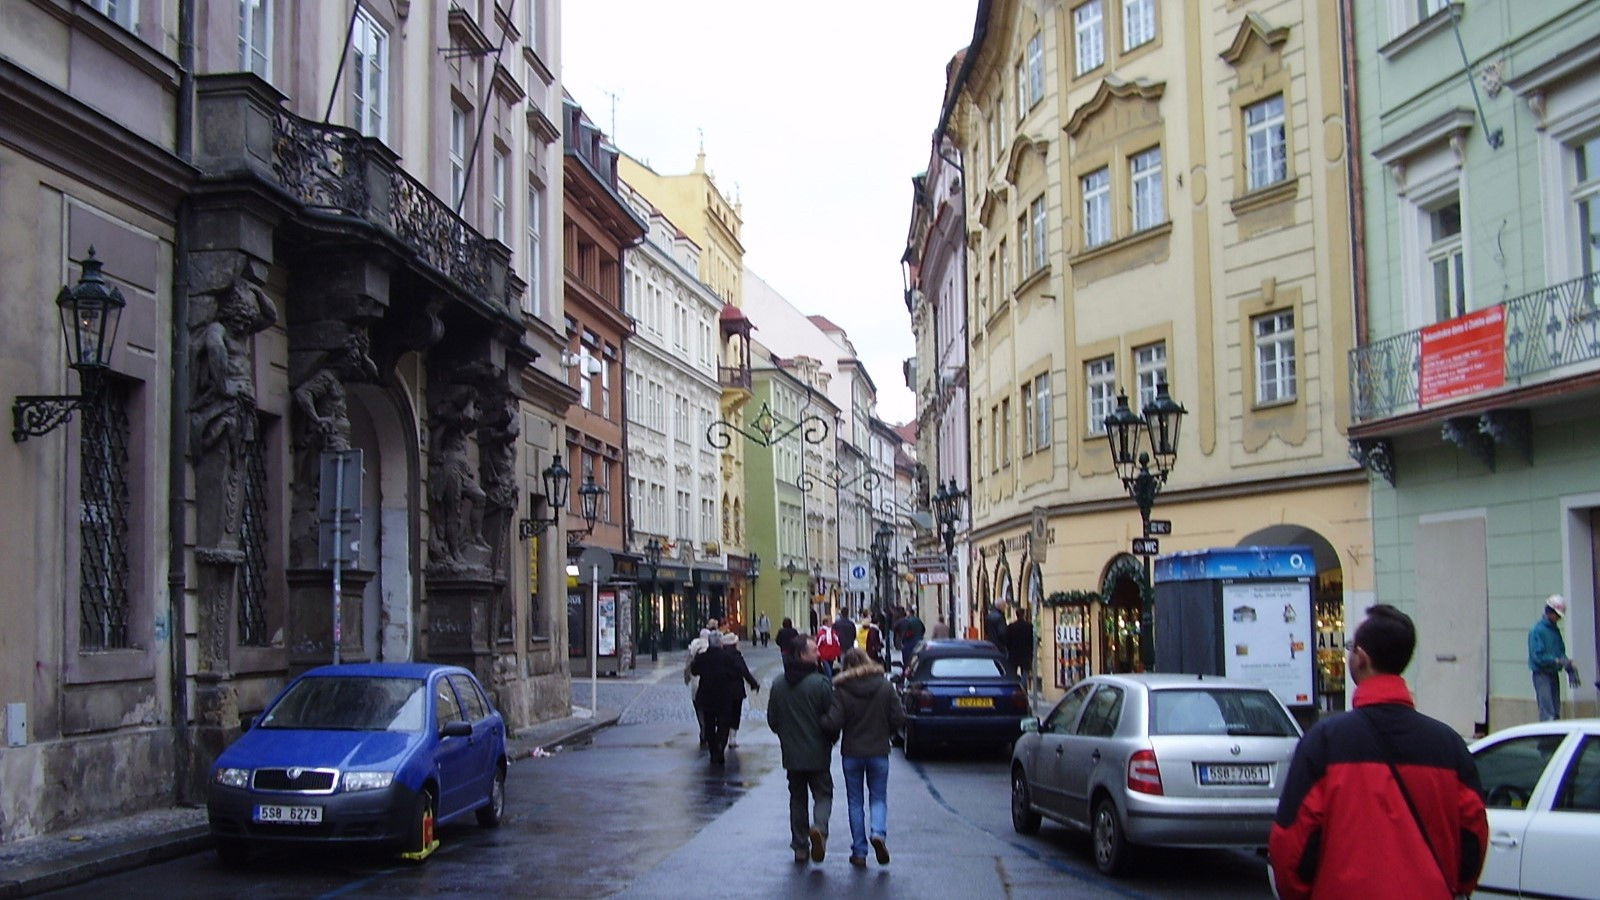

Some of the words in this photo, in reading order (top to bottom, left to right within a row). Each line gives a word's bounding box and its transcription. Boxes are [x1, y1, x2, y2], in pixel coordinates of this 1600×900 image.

[1144, 541, 1157, 553] WC
[1057, 627, 1081, 642] SALE
[1239, 768, 1264, 780] 7051
[290, 808, 317, 819] 6279
